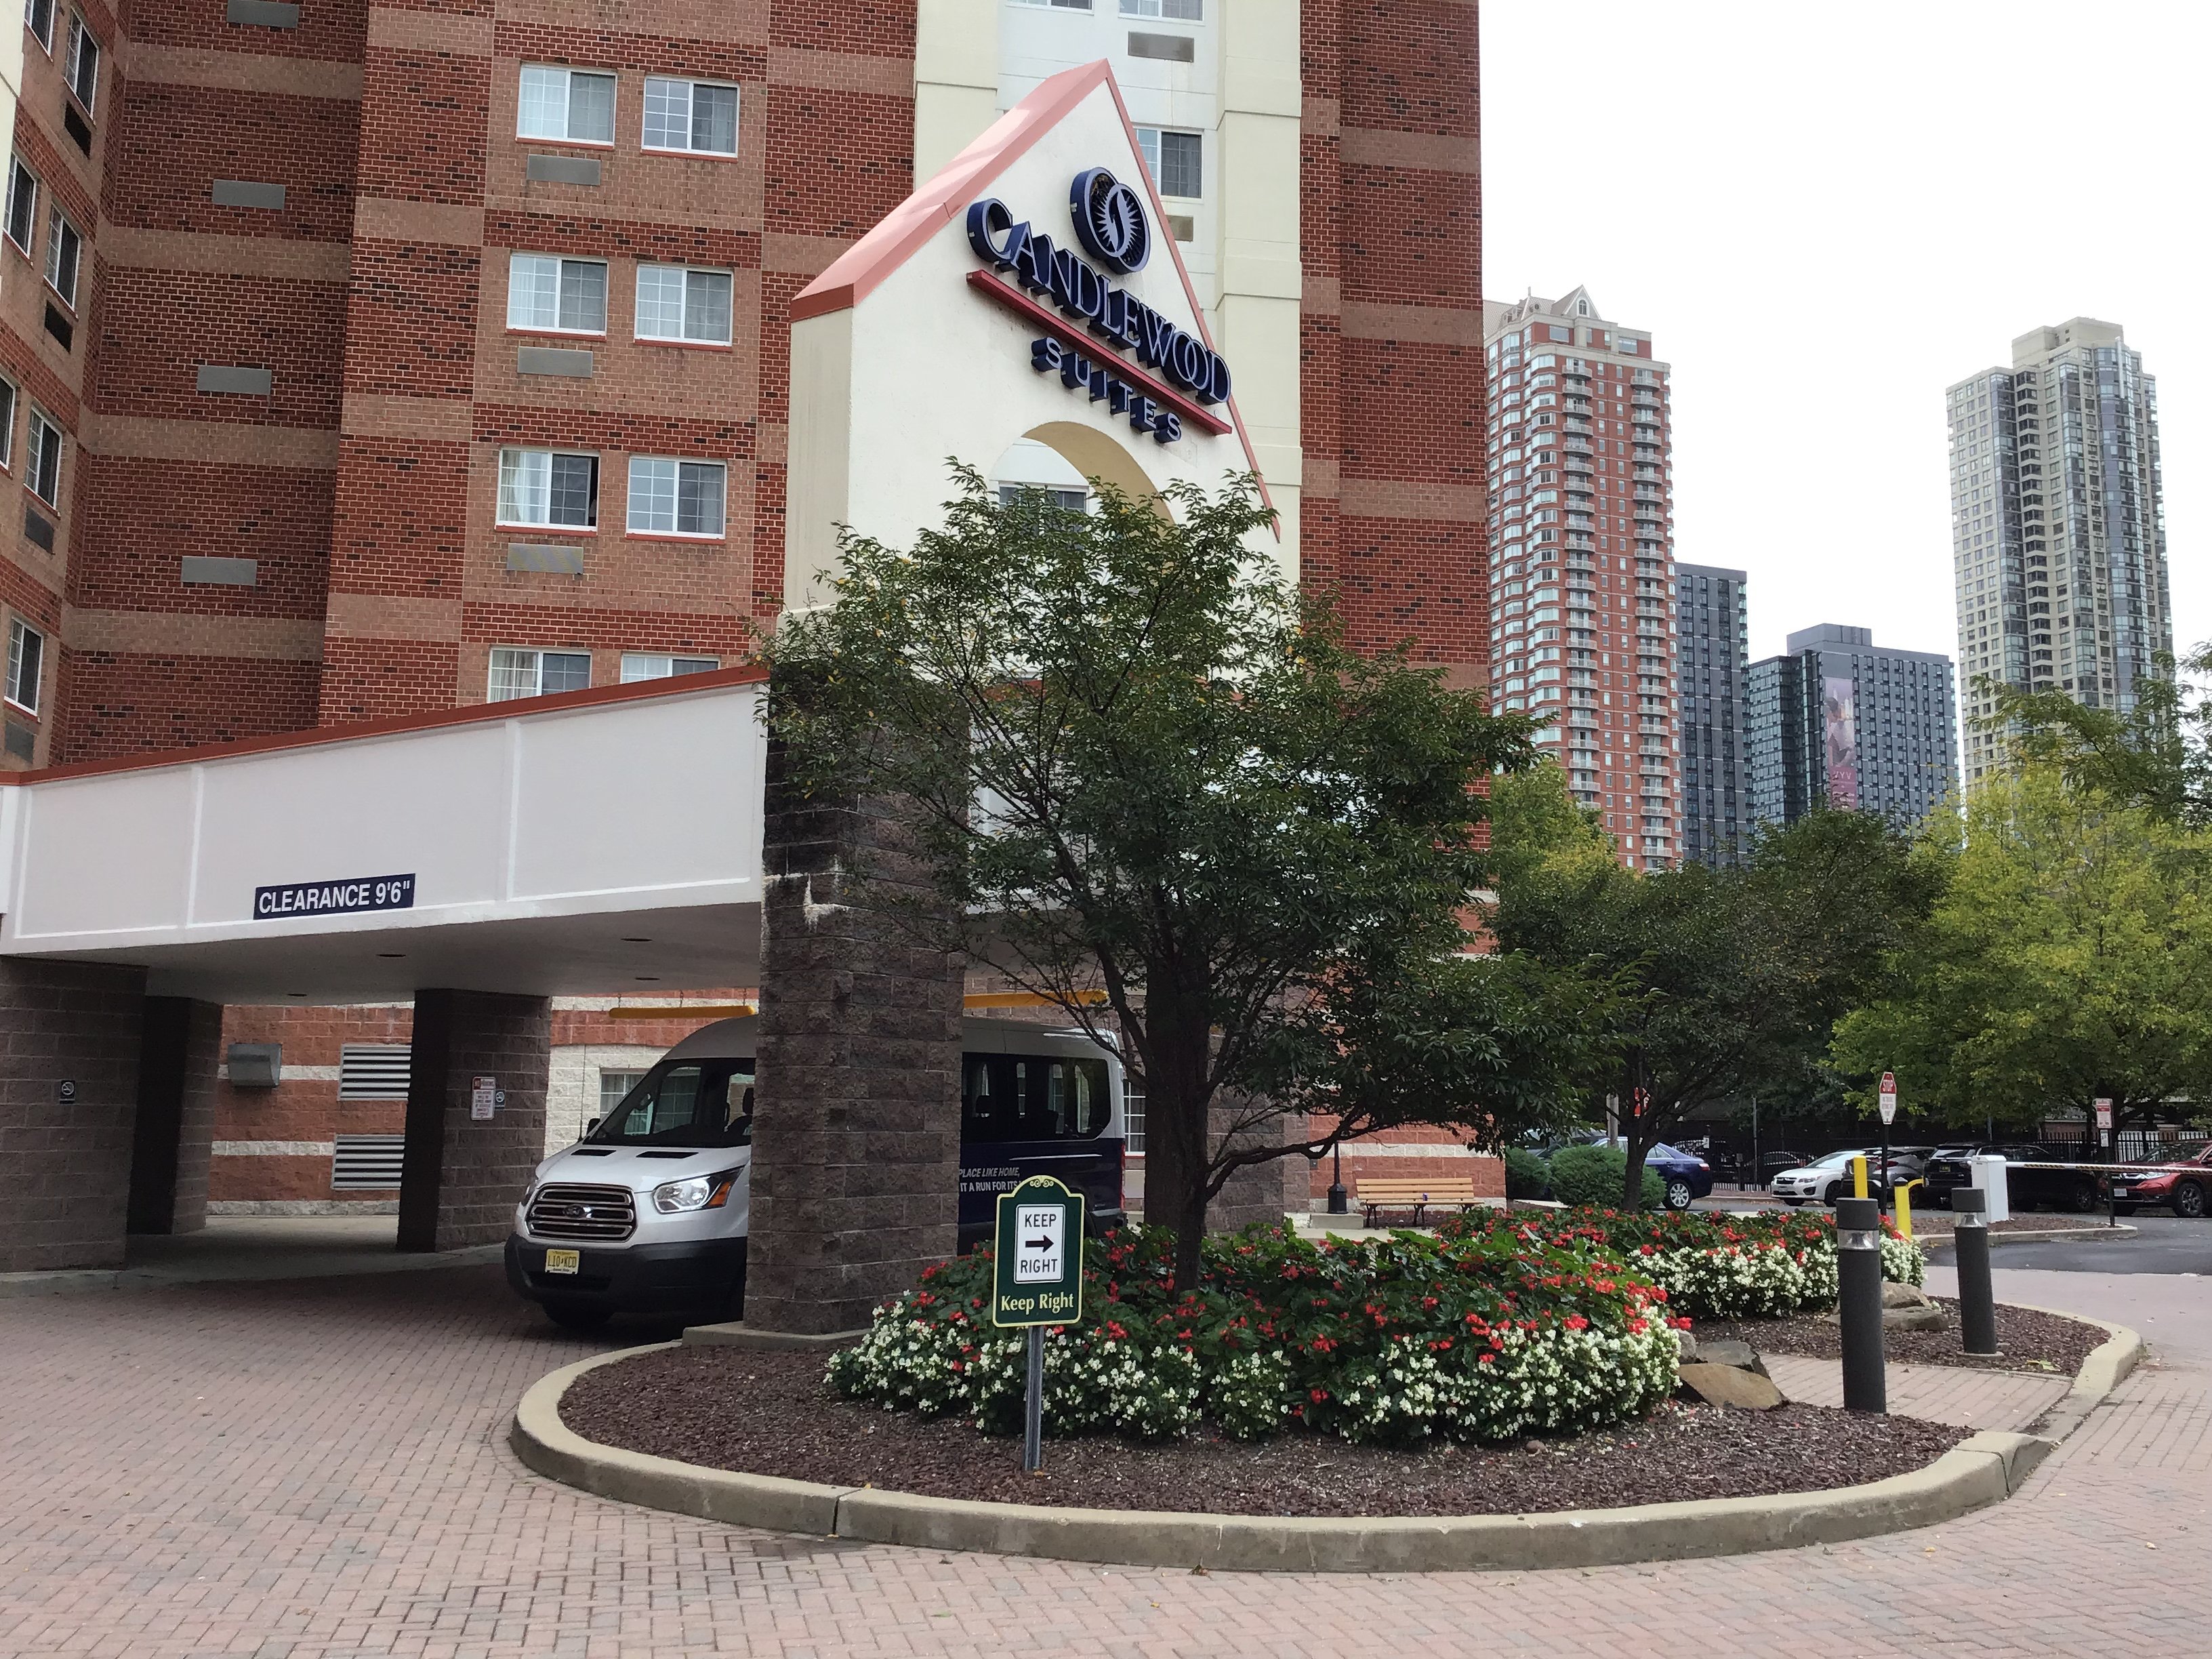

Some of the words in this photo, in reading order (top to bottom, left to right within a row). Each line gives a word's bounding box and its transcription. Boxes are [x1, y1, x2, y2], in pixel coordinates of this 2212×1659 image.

[966, 198, 1231, 404] CANDLEWOOD
[1031, 337, 1182, 444] SUITES
[259, 883, 371, 914] CLEARANCE
[375, 880, 411, 905] 9'6"
[982, 1167, 998, 1177] LIKE
[998, 1167, 1020, 1178] HOME,
[960, 1183, 968, 1192] IT
[968, 1182, 975, 1192] A
[976, 1181, 991, 1191] RUN
[992, 1181, 1006, 1191] FOR
[1025, 1213, 1057, 1227] KEEP
[1020, 1258, 1058, 1273] RIGHT
[1001, 1295, 1035, 1315] Keep
[1039, 1291, 1073, 1313] Right
